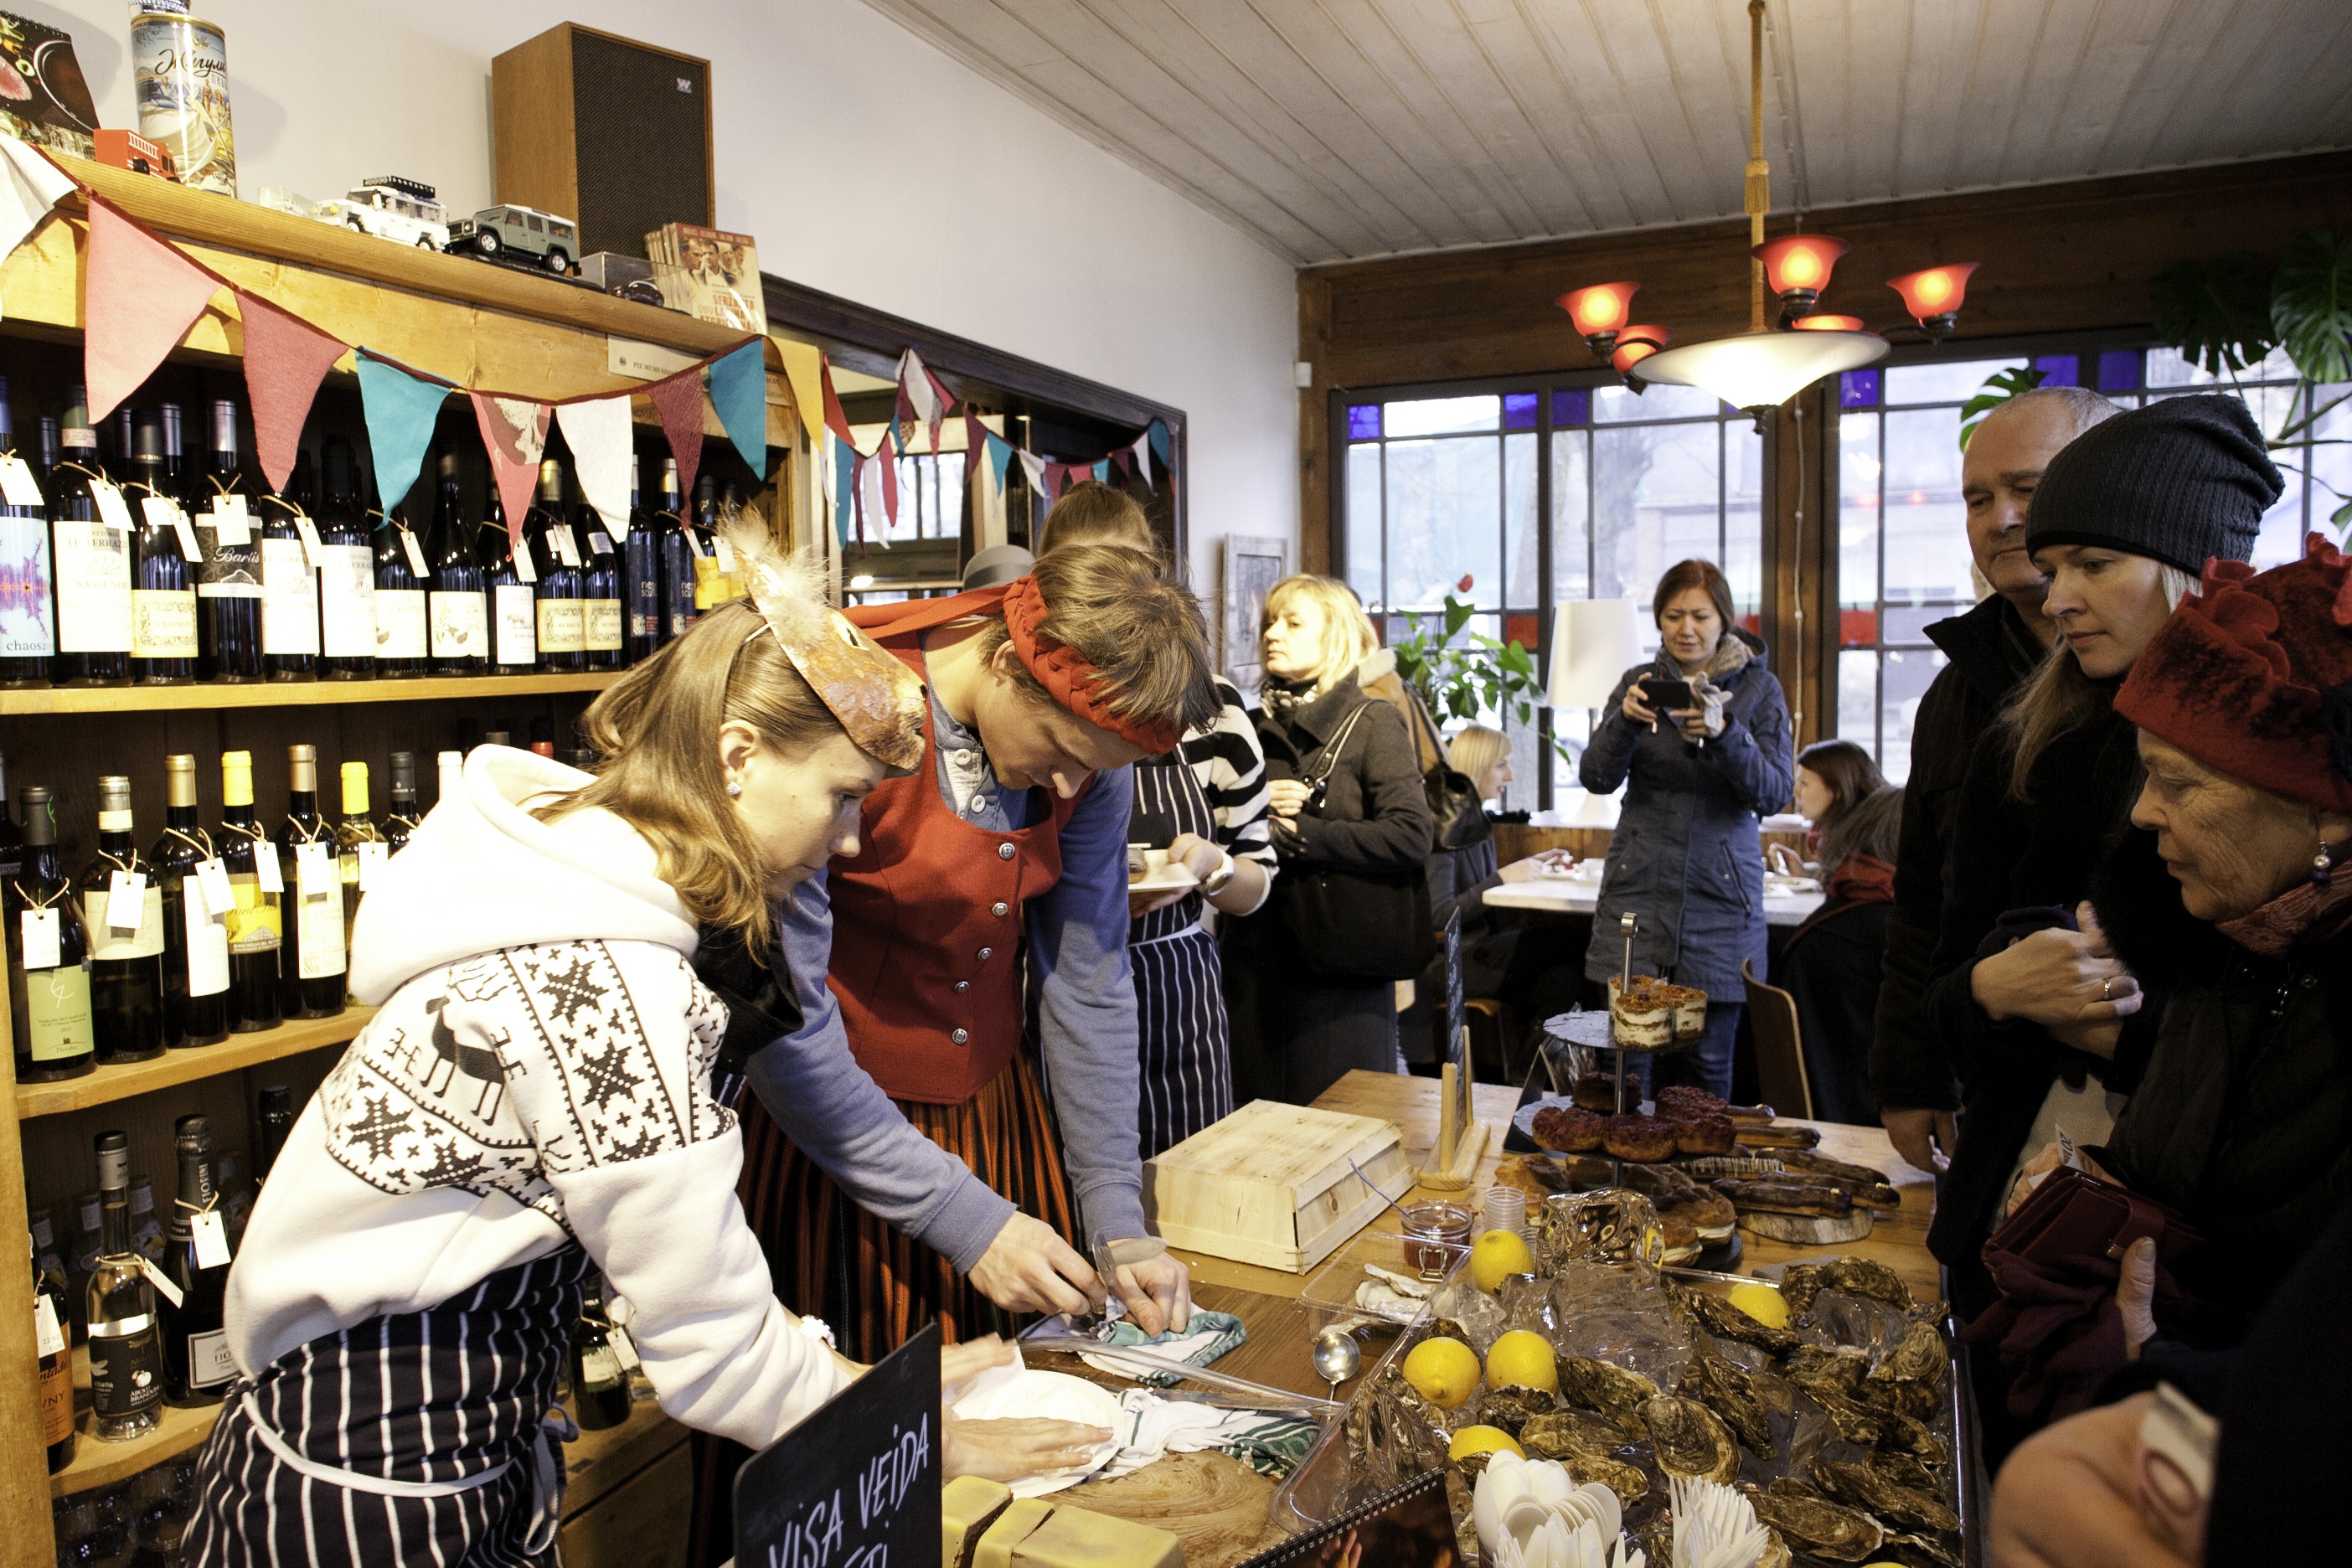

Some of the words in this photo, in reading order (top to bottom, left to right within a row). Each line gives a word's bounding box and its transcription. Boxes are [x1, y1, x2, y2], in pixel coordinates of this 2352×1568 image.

[7, 640, 41, 651] chaos
[199, 1163, 212, 1204] FIORINI
[39, 1360, 68, 1381] ntado
